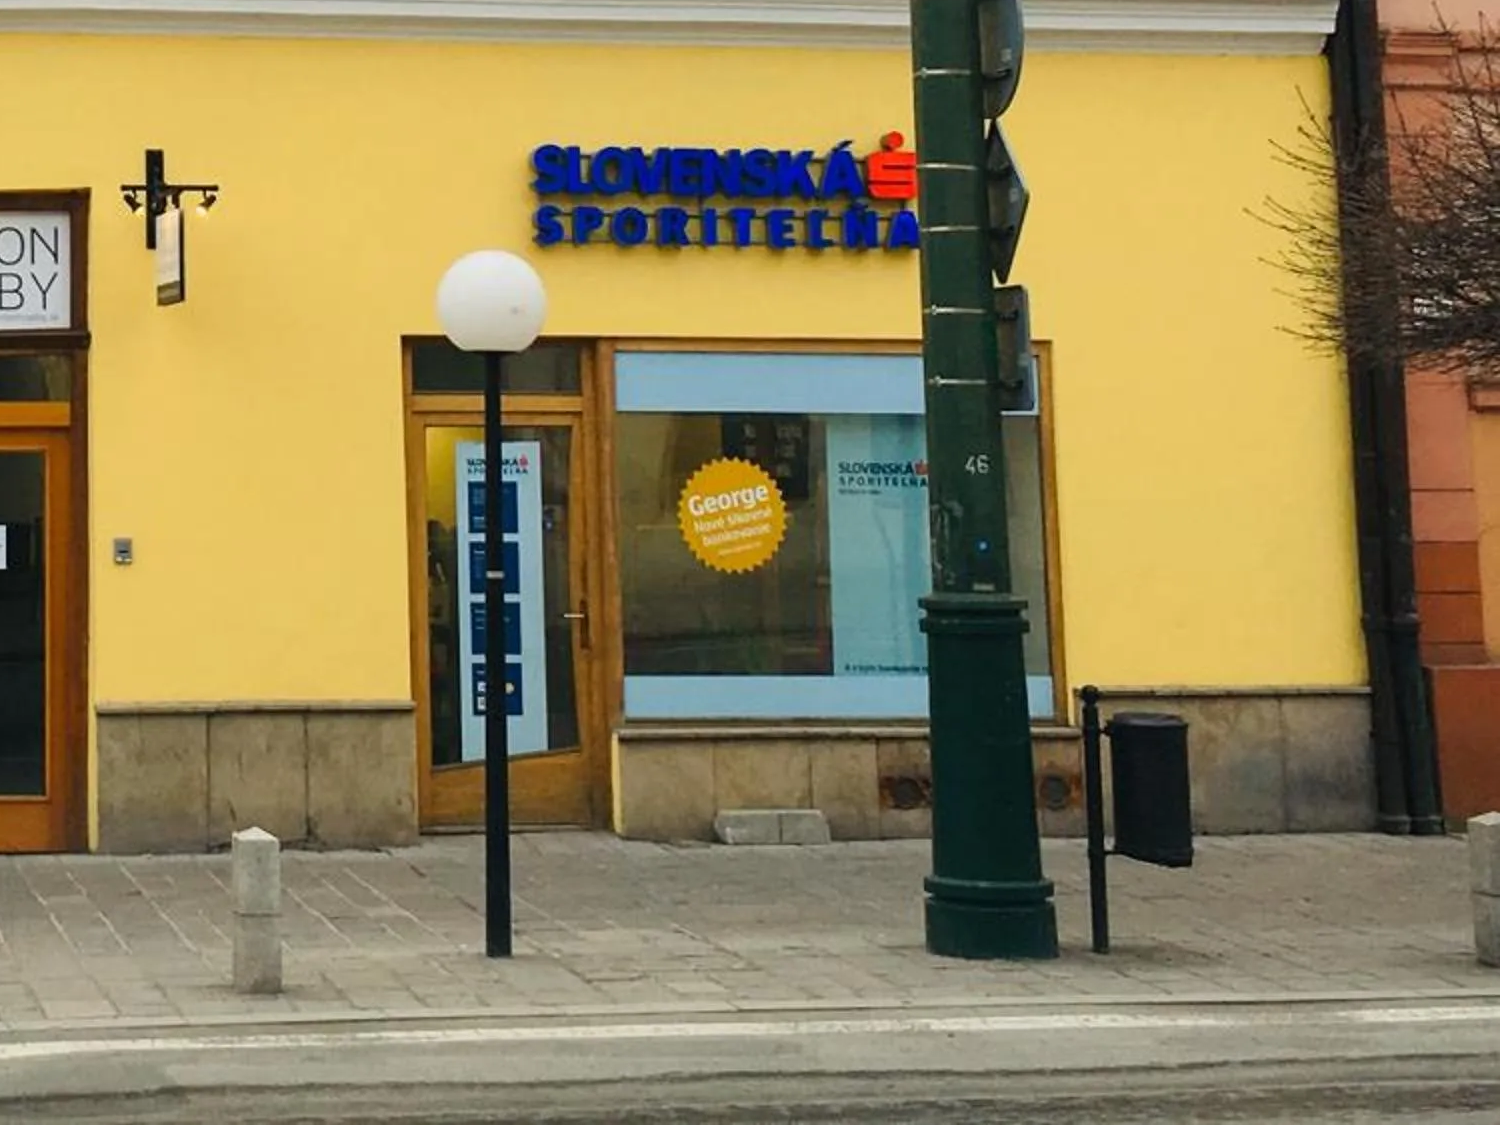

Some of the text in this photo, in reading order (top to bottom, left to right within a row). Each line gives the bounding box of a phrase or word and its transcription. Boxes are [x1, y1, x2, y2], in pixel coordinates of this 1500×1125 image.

[531, 140, 865, 199] SLOVENSKÁ
[532, 200, 921, 250] SPORITEĽŇA
[964, 454, 990, 475] 46
[688, 485, 769, 516] George
